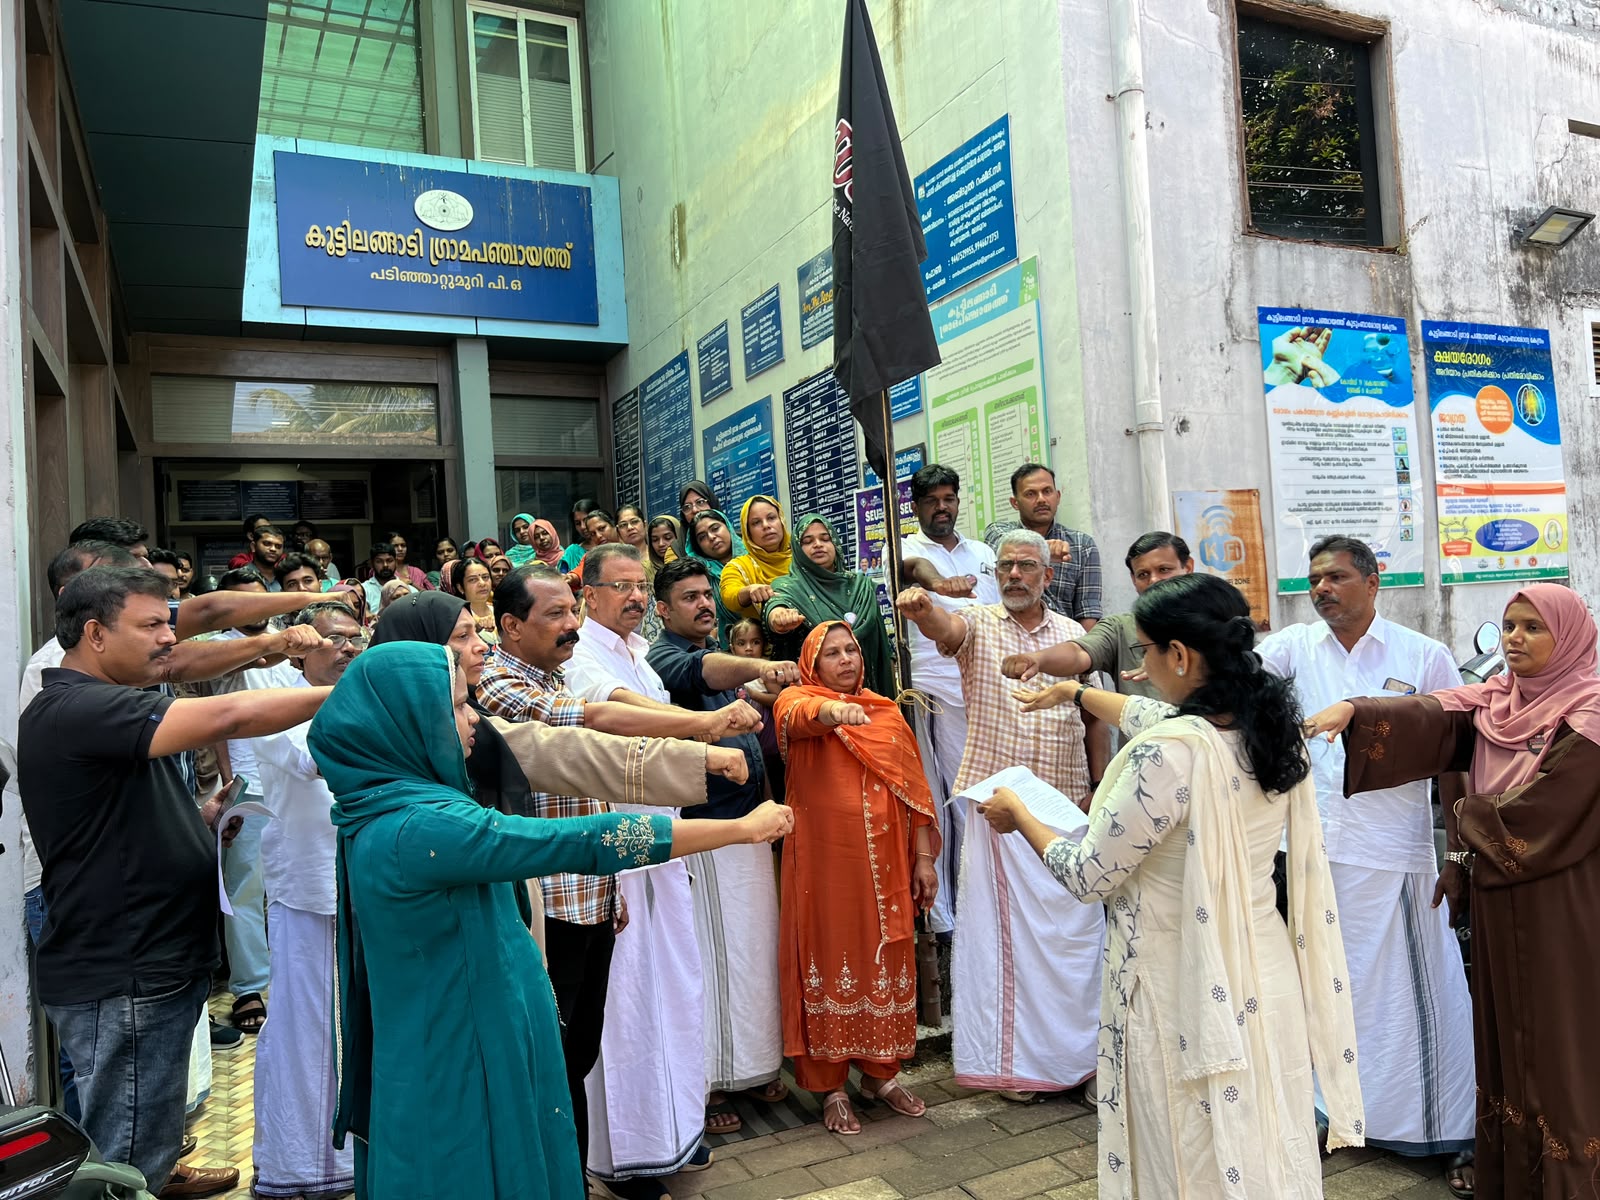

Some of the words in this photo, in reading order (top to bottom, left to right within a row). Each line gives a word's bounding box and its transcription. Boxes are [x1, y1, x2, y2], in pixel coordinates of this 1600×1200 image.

[305, 220, 424, 257] കൂട്ടിലങ്ങാടി
[429, 236, 573, 270] ഗ്രാമപഞ്ചായത്ത്
[370, 266, 484, 290] പടിഞ്ഞാറ്റുമുറി
[1434, 351, 1491, 366] ക്ഷയരോഗം
